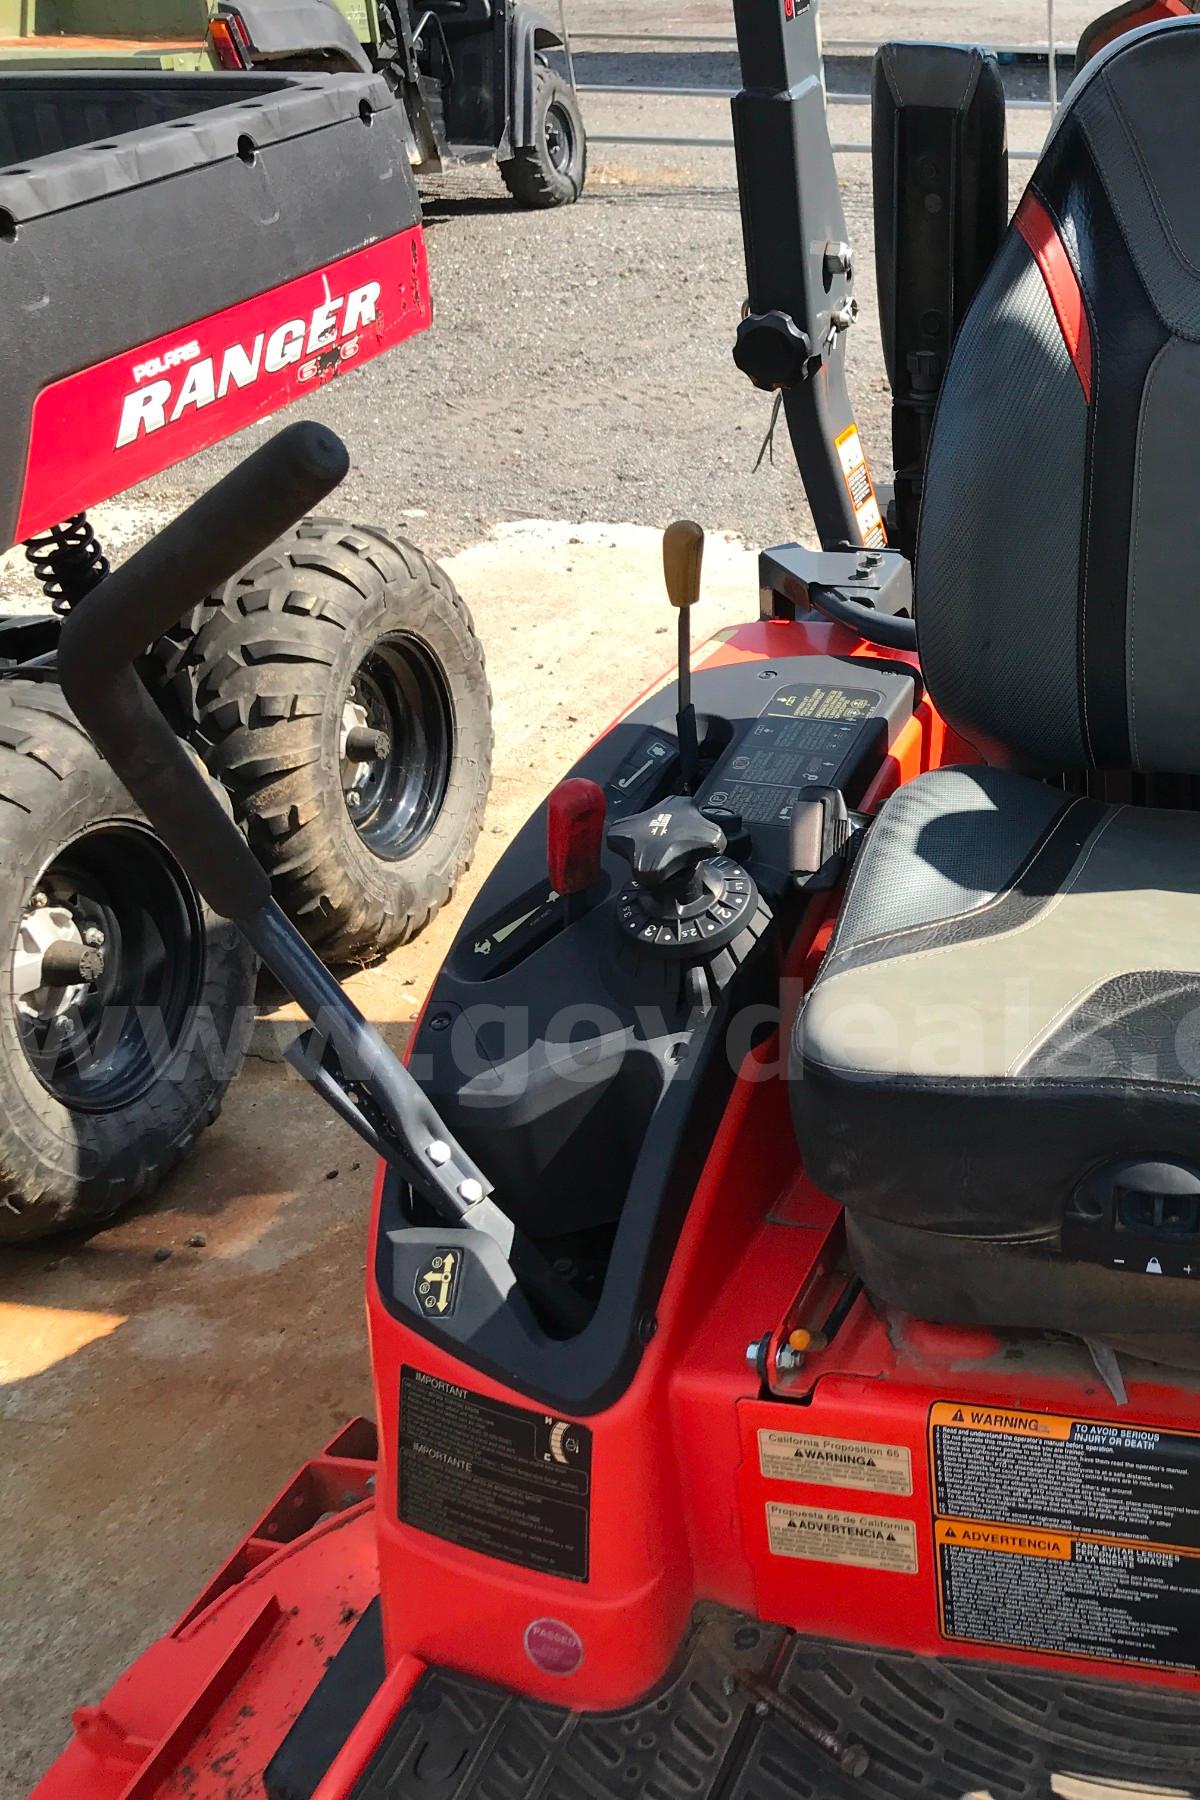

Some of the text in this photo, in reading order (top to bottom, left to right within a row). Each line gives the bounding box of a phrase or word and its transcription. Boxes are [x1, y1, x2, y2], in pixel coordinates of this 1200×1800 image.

[114, 281, 381, 450] RANGER
[132, 339, 201, 383] POLARIS
[716, 906, 732, 919] 2
[644, 923, 657, 937] 3
[681, 927, 698, 939] 2.5
[415, 1372, 468, 1400] IMPORTANT
[970, 1412, 1039, 1432] WARNING
[942, 1426, 957, 1434] Read
[958, 1428, 968, 1436] and
[969, 1430, 1002, 1440] understand
[1042, 1440, 1064, 1449] manual
[1074, 1432, 1155, 1451] INJURY OR DEATH
[1075, 1425, 1159, 1442] TO AVOID SERIOUS
[768, 1433, 900, 1458] California Proposition 65
[412, 1442, 473, 1472] IMPORTANTE
[804, 1449, 867, 1466] WARNING
[771, 1505, 910, 1532] Propuesta 65 de California
[799, 1519, 884, 1541] ADVERTENCIA
[962, 1529, 1061, 1552] ADVERTENCIA
[1075, 1542, 1180, 1562] PARA EVITAR LESIONES
[1075, 1548, 1173, 1568] PERSONALES GRAVES
[1084, 1555, 1096, 1563] LA
[1098, 1557, 1134, 1568] MUERTE
